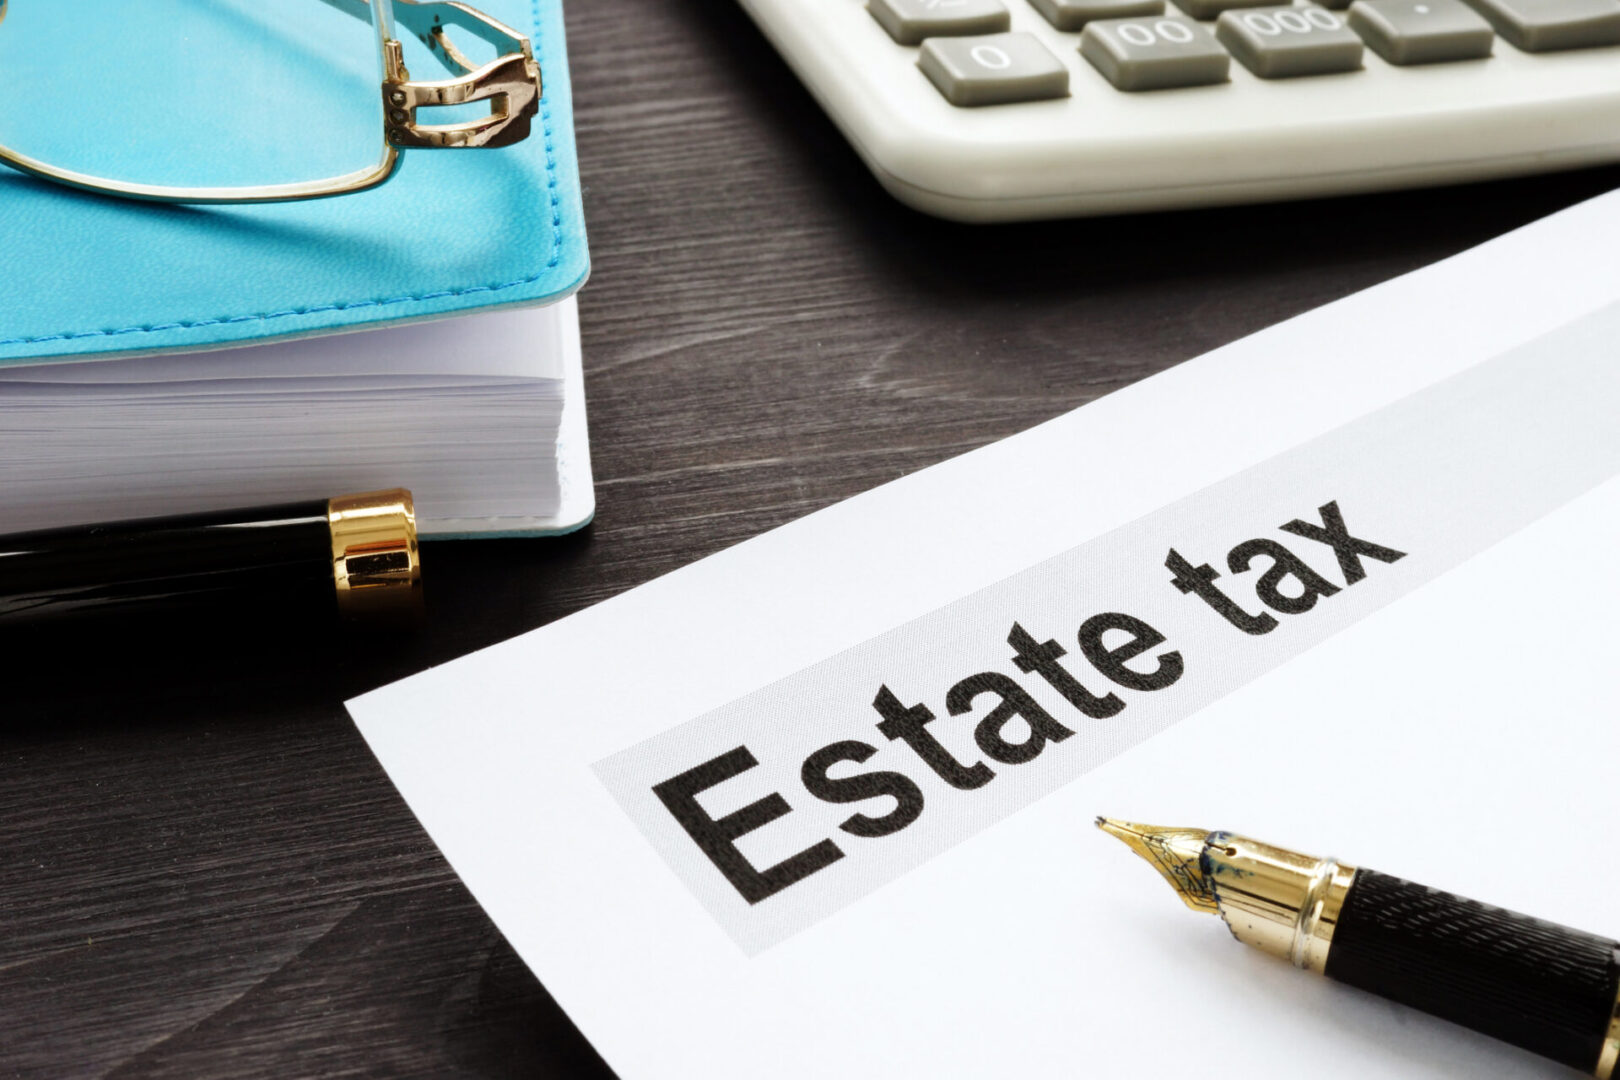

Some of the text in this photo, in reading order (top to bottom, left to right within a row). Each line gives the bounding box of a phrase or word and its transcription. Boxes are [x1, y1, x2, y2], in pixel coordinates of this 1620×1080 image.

[1117, 20, 1194, 46] 00
[1244, 8, 1341, 36] 000
[971, 45, 1011, 70] 0
[652, 500, 1407, 905] Estate tax
